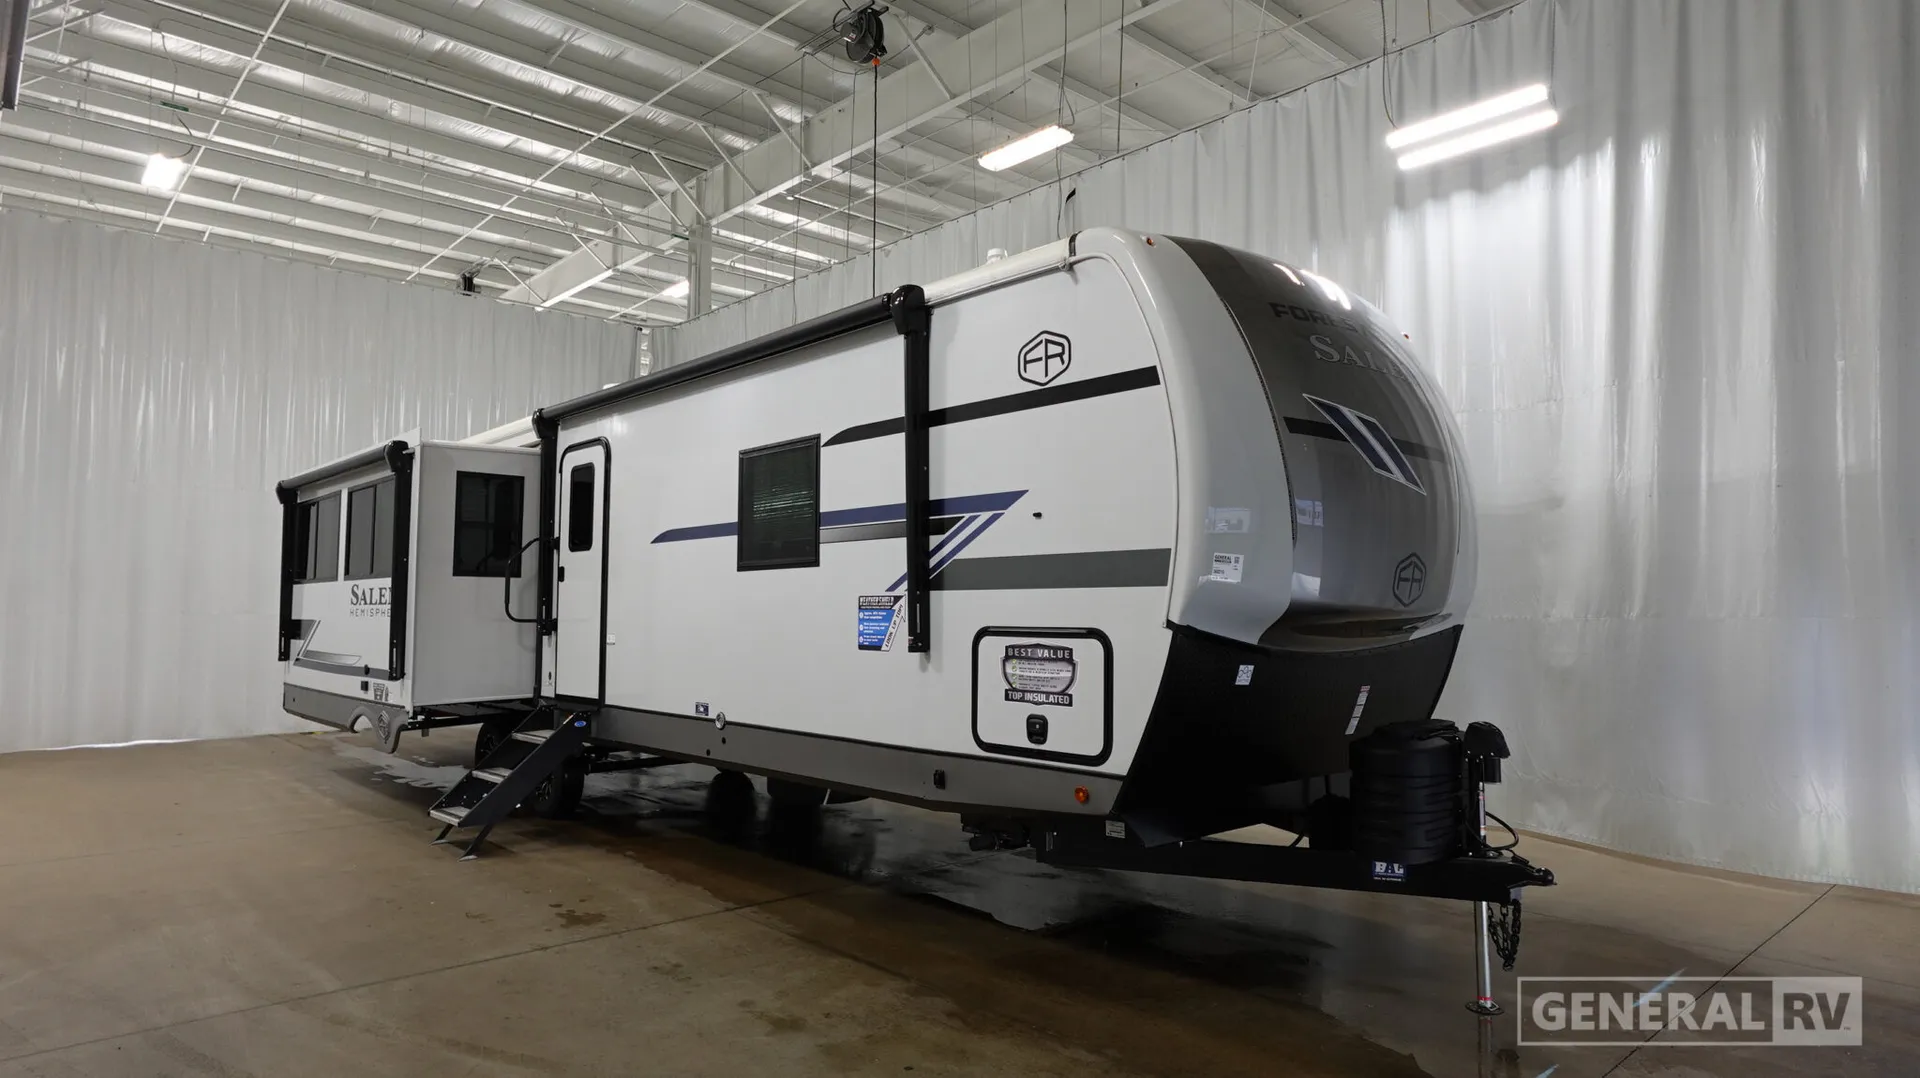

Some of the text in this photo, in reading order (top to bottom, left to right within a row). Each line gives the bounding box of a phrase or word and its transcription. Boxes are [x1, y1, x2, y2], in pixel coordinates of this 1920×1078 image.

[1268, 302, 1360, 333] FORES
[1022, 337, 1067, 379] FR
[1309, 334, 1406, 380] SALE
[349, 608, 391, 618] HEMISPHE
[1007, 647, 1070, 659] BEST VALUE
[1007, 690, 1070, 705] TOP INSULATED
